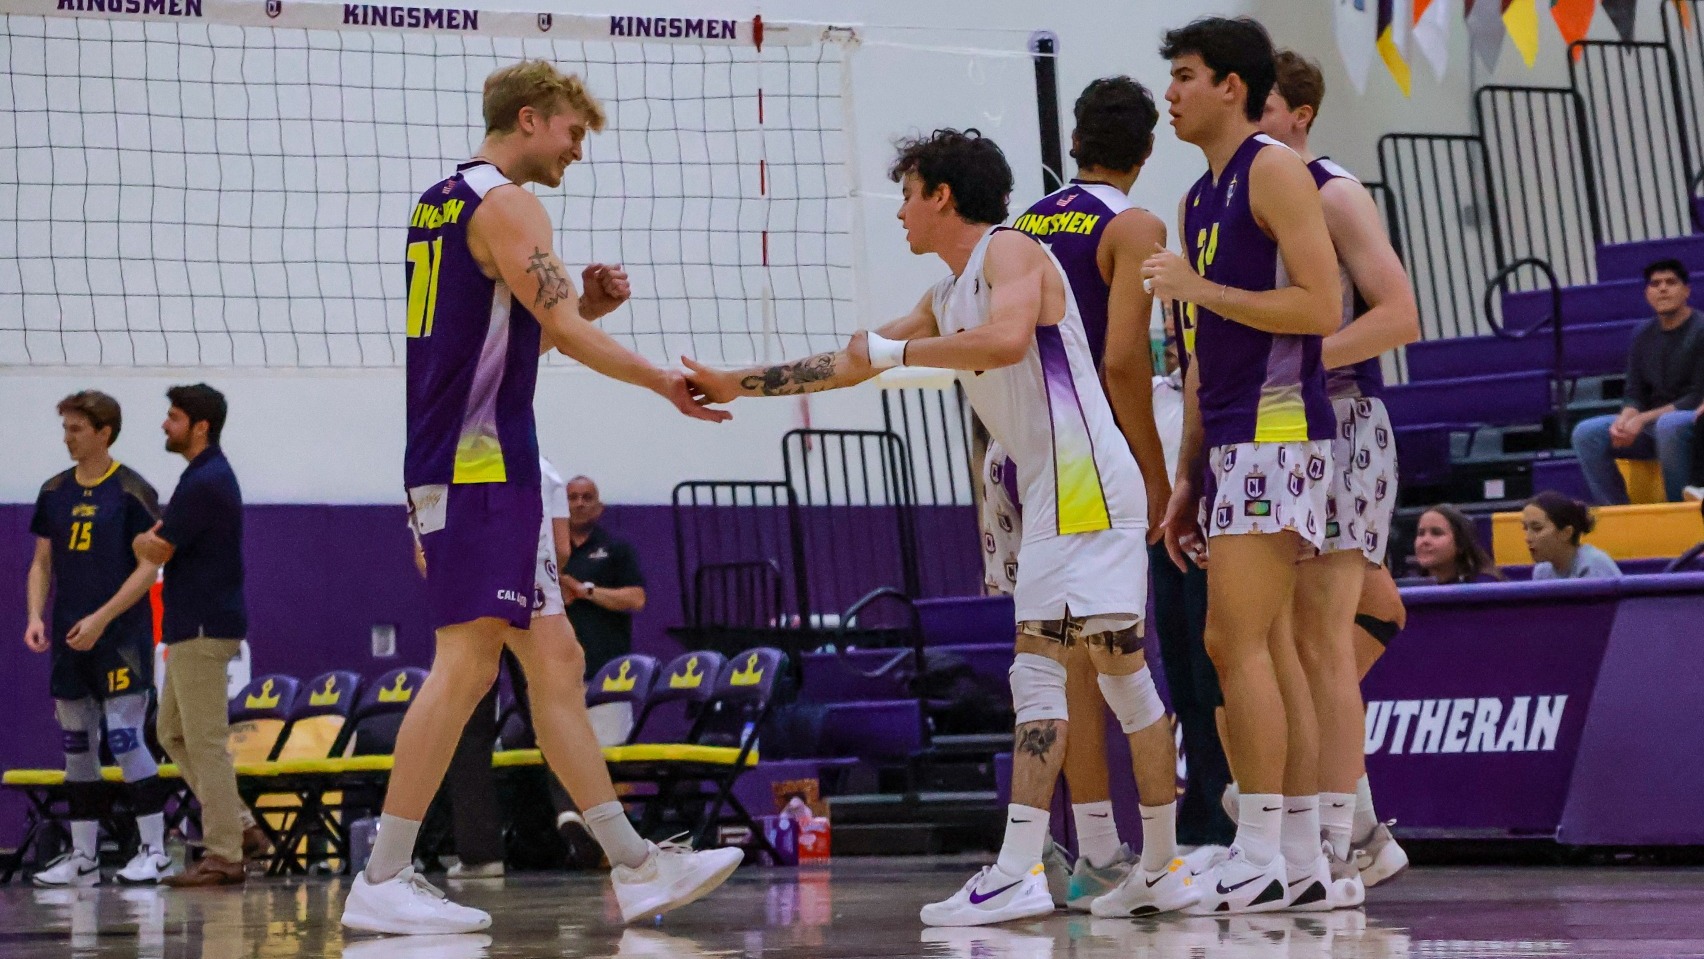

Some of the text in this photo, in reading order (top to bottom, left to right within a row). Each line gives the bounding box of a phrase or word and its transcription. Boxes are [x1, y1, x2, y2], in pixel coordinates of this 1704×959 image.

[343, 3, 479, 31] KINGSMEN
[609, 15, 738, 40] KINGSMEN
[69, 521, 93, 550] 15
[497, 589, 517, 601] CAL
[107, 667, 131, 693] 15
[1364, 694, 1569, 755] UTHERAN
